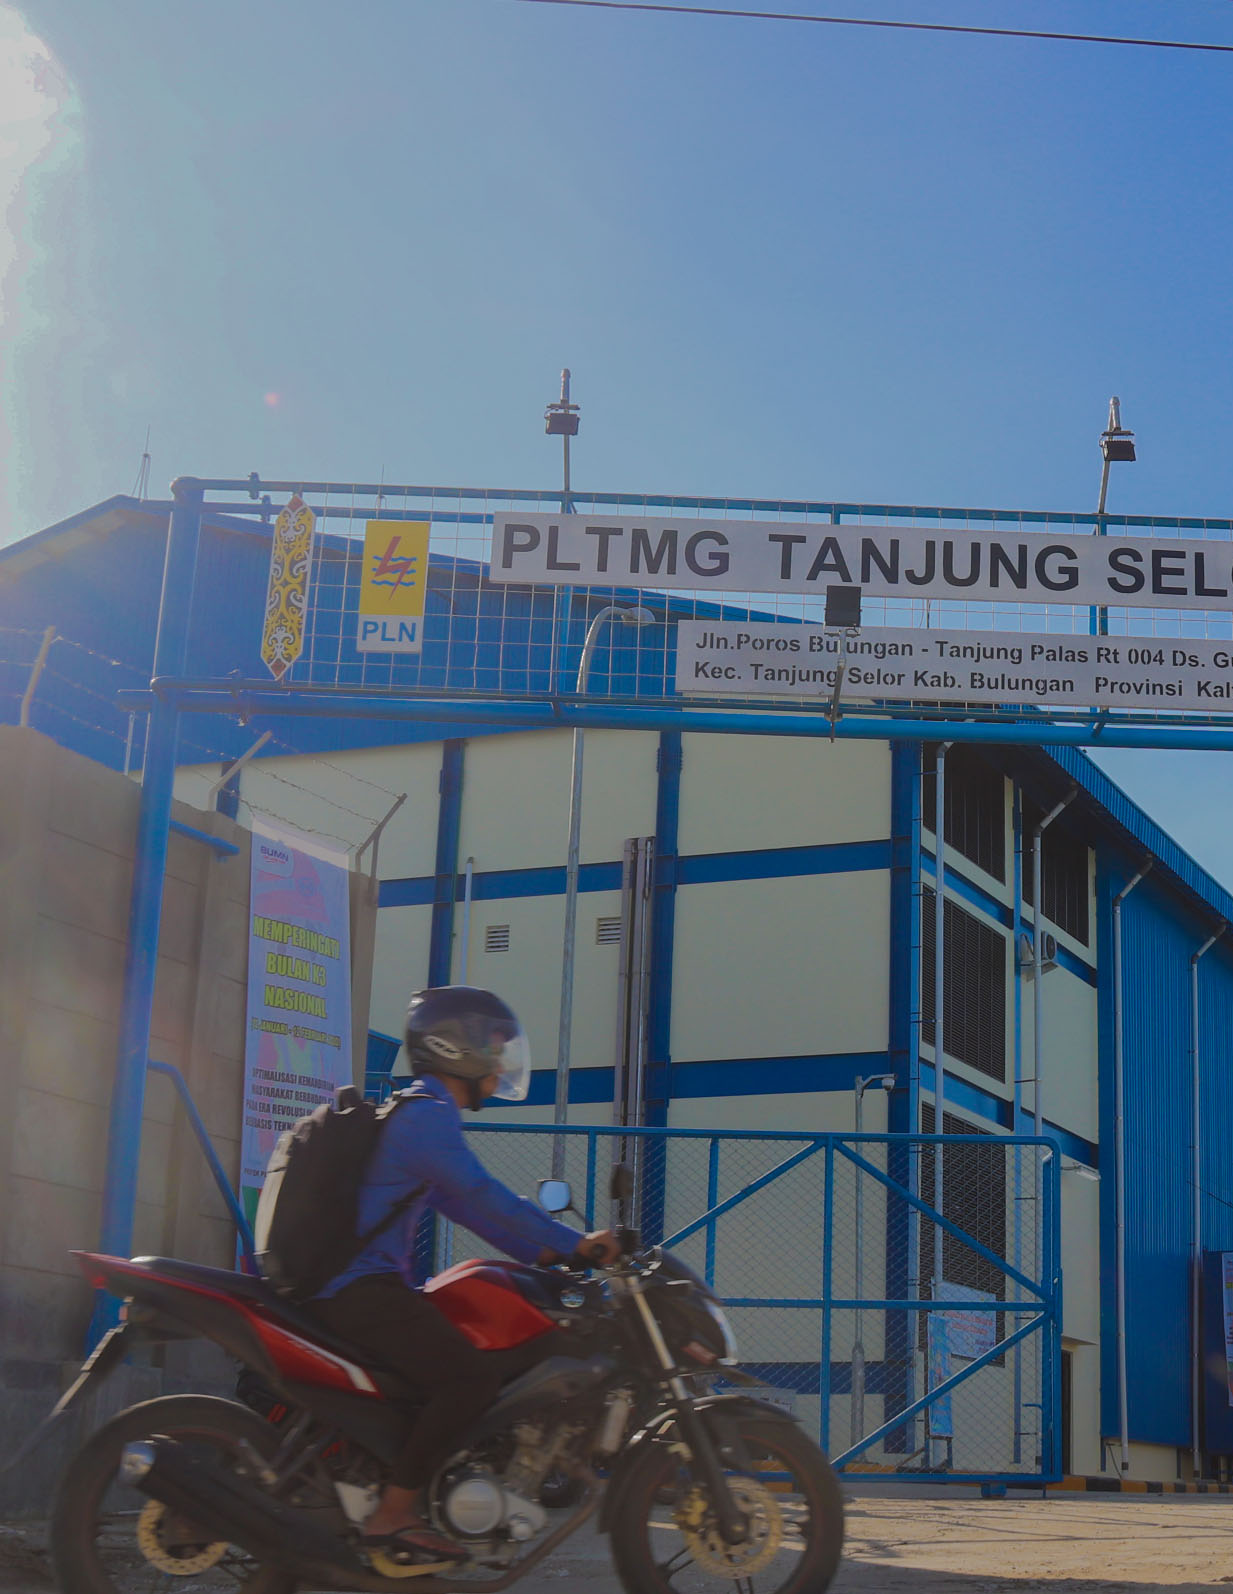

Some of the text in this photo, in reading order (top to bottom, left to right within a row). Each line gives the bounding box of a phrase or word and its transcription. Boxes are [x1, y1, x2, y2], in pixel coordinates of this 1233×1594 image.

[501, 523, 731, 577] PLTMG
[769, 533, 1080, 592] TANJUNG
[361, 621, 417, 642] PLN
[696, 632, 801, 651] Jln.Poros
[809, 636, 913, 659] Buungan
[935, 640, 1023, 664] Tanjung
[1031, 644, 1089, 663] Palas
[1096, 647, 1120, 664] Rt
[1128, 648, 1165, 666] 004
[1172, 650, 1206, 668] Ds.
[694, 661, 742, 680] Kec.
[750, 663, 838, 688] Tanjung
[848, 667, 906, 686] Selor
[914, 670, 962, 688] Kab.
[970, 672, 1075, 696] Bulungan
[1095, 677, 1183, 697] Provinsi
[260, 845, 289, 862] BUMN
[252, 914, 341, 960] MEMPERINGATI
[266, 951, 327, 987] BULAN K3
[264, 984, 328, 1019] NASIONAL
